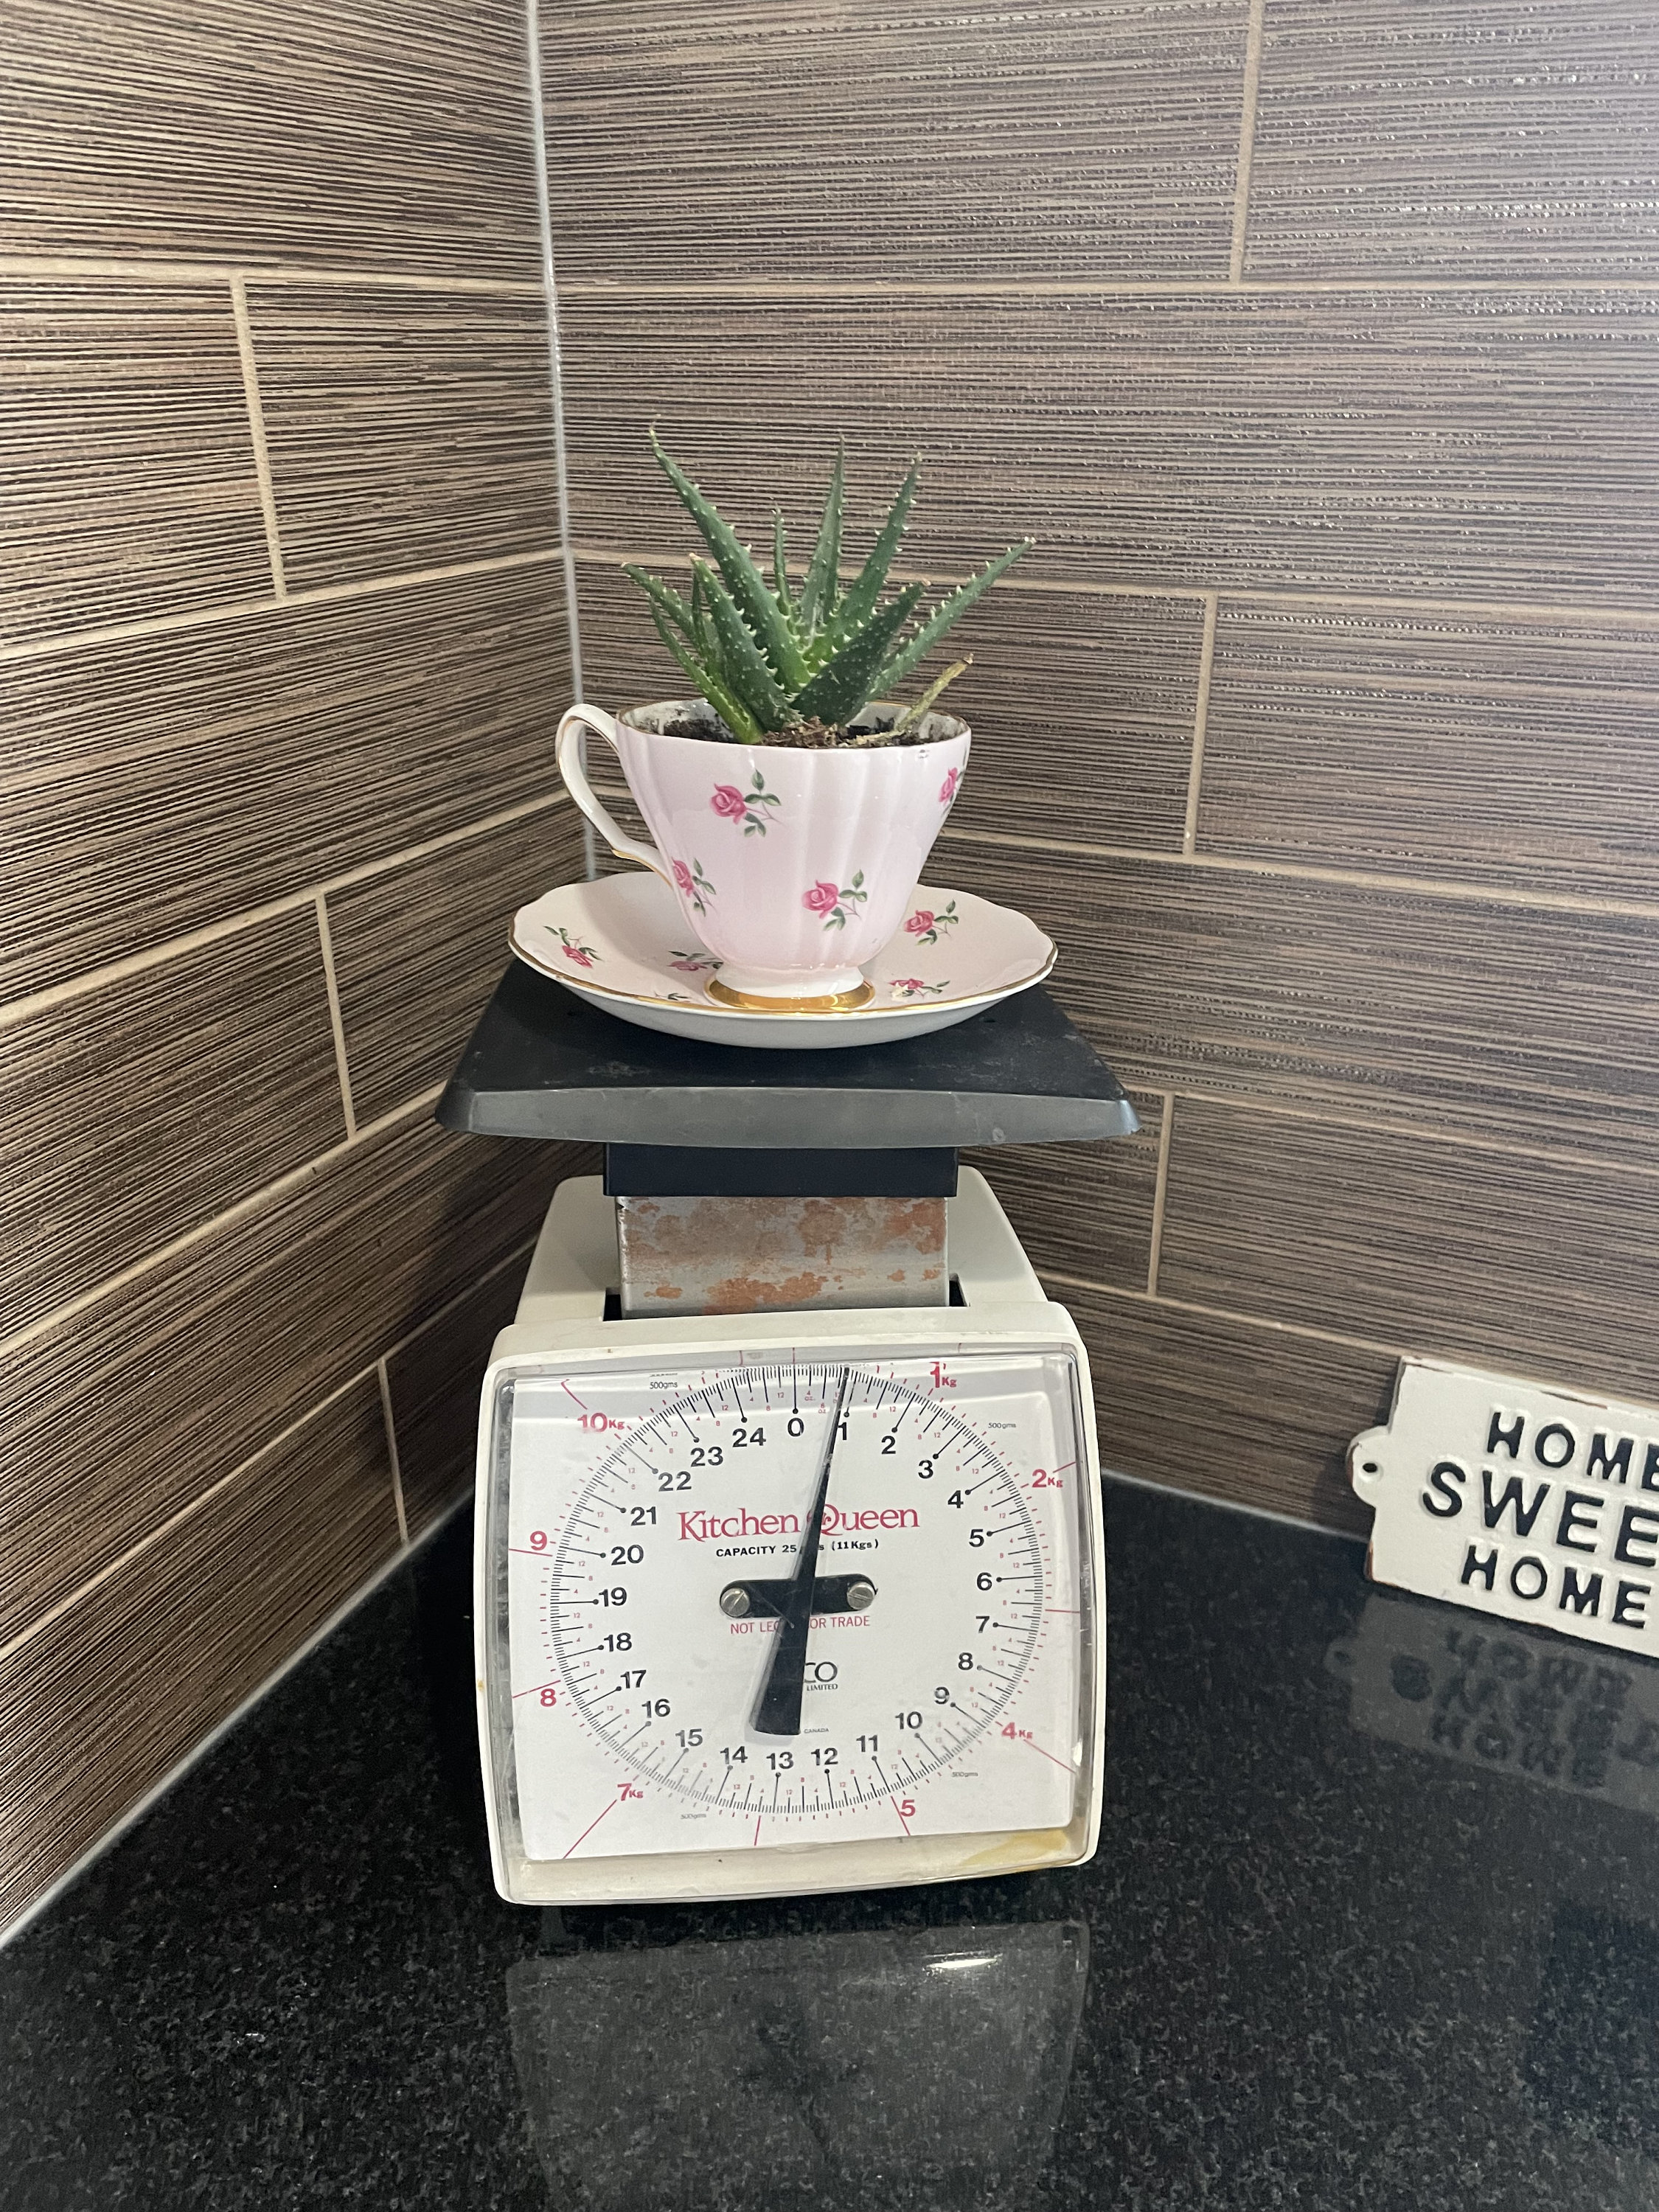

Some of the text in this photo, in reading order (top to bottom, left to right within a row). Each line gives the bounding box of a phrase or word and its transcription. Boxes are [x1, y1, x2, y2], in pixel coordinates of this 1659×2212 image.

[650, 1381, 678, 1390] 500gms
[787, 1418, 804, 1436] 0
[837, 1422, 847, 1440] 1
[732, 1427, 766, 1447] 24
[882, 1436, 896, 1454] 2
[690, 1447, 723, 1467] 23
[918, 1460, 933, 1478] 3
[658, 1471, 692, 1492] 22
[948, 1491, 964, 1508] 4
[630, 1506, 656, 1526] 21
[677, 1503, 920, 1542] Kitchen Queen
[530, 1531, 547, 1550] 9
[969, 1529, 984, 1547] 5
[611, 1545, 644, 1565] 20
[716, 1545, 776, 1557] CAPACITY
[782, 1545, 797, 1553] 25
[977, 1572, 992, 1590] 6
[1461, 1545, 1652, 1629] HOME
[599, 1587, 627, 1606] 19
[731, 1623, 755, 1634] NOT
[809, 1618, 827, 1629] OR
[831, 1615, 871, 1627] TRADE
[976, 1616, 990, 1633] 7
[603, 1633, 632, 1651] 18
[958, 1653, 973, 1670] 8
[620, 1670, 647, 1688] 17
[807, 1683, 838, 1691] LIMITED
[540, 1688, 557, 1707] 8
[934, 1687, 950, 1704] 9
[641, 1700, 670, 1717] 16
[895, 1711, 922, 1729] 10
[675, 1729, 703, 1747] 15
[856, 1736, 877, 1752] 11
[720, 1746, 748, 1764] 14
[766, 1752, 793, 1770] 13
[811, 1748, 838, 1765] 12
[900, 1800, 915, 1817] 5
